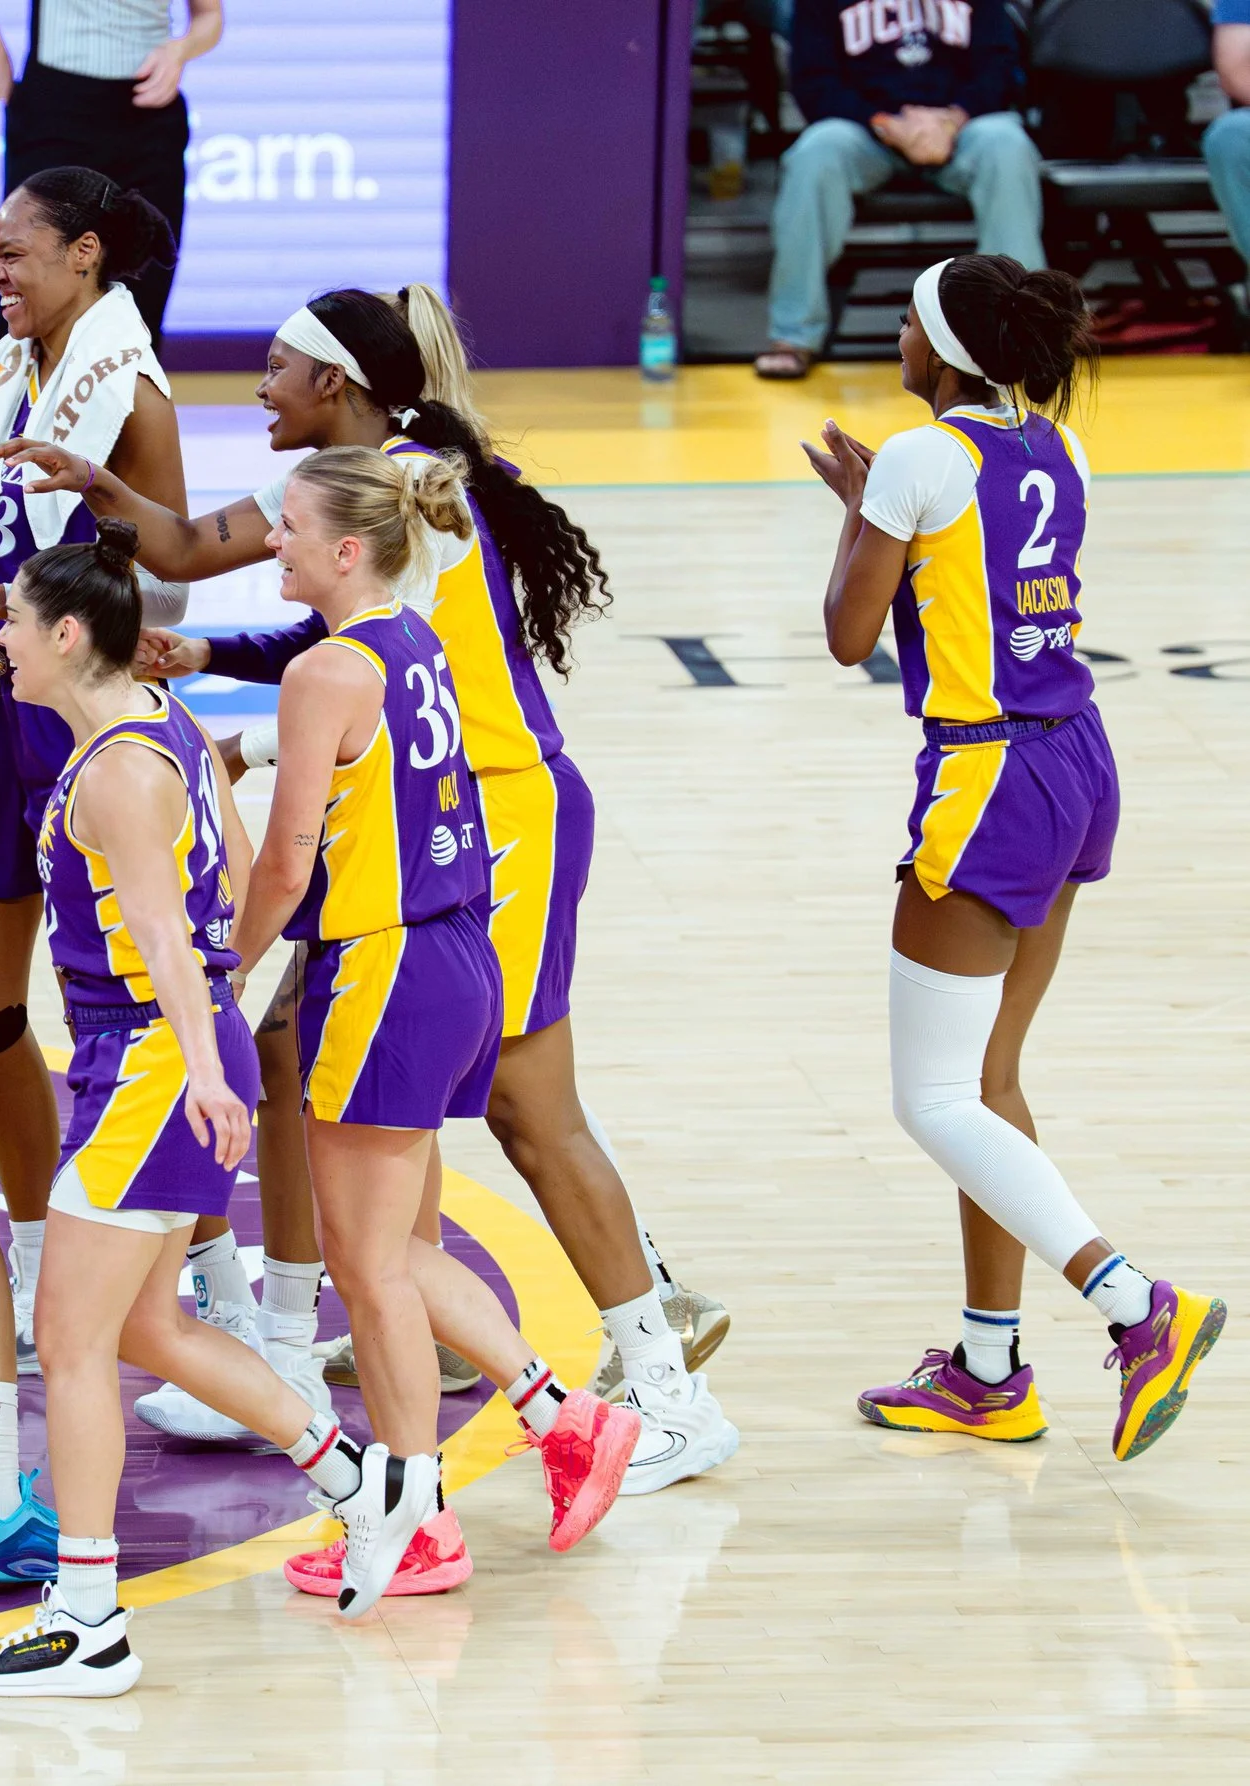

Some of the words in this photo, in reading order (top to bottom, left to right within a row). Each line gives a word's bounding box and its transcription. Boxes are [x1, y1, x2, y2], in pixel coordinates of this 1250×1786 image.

[185, 110, 380, 202] arn.
[52, 346, 144, 448] ATORA
[1017, 469, 1057, 570] 2
[1015, 575, 1073, 616] JACKSON
[404, 651, 462, 770] 35
